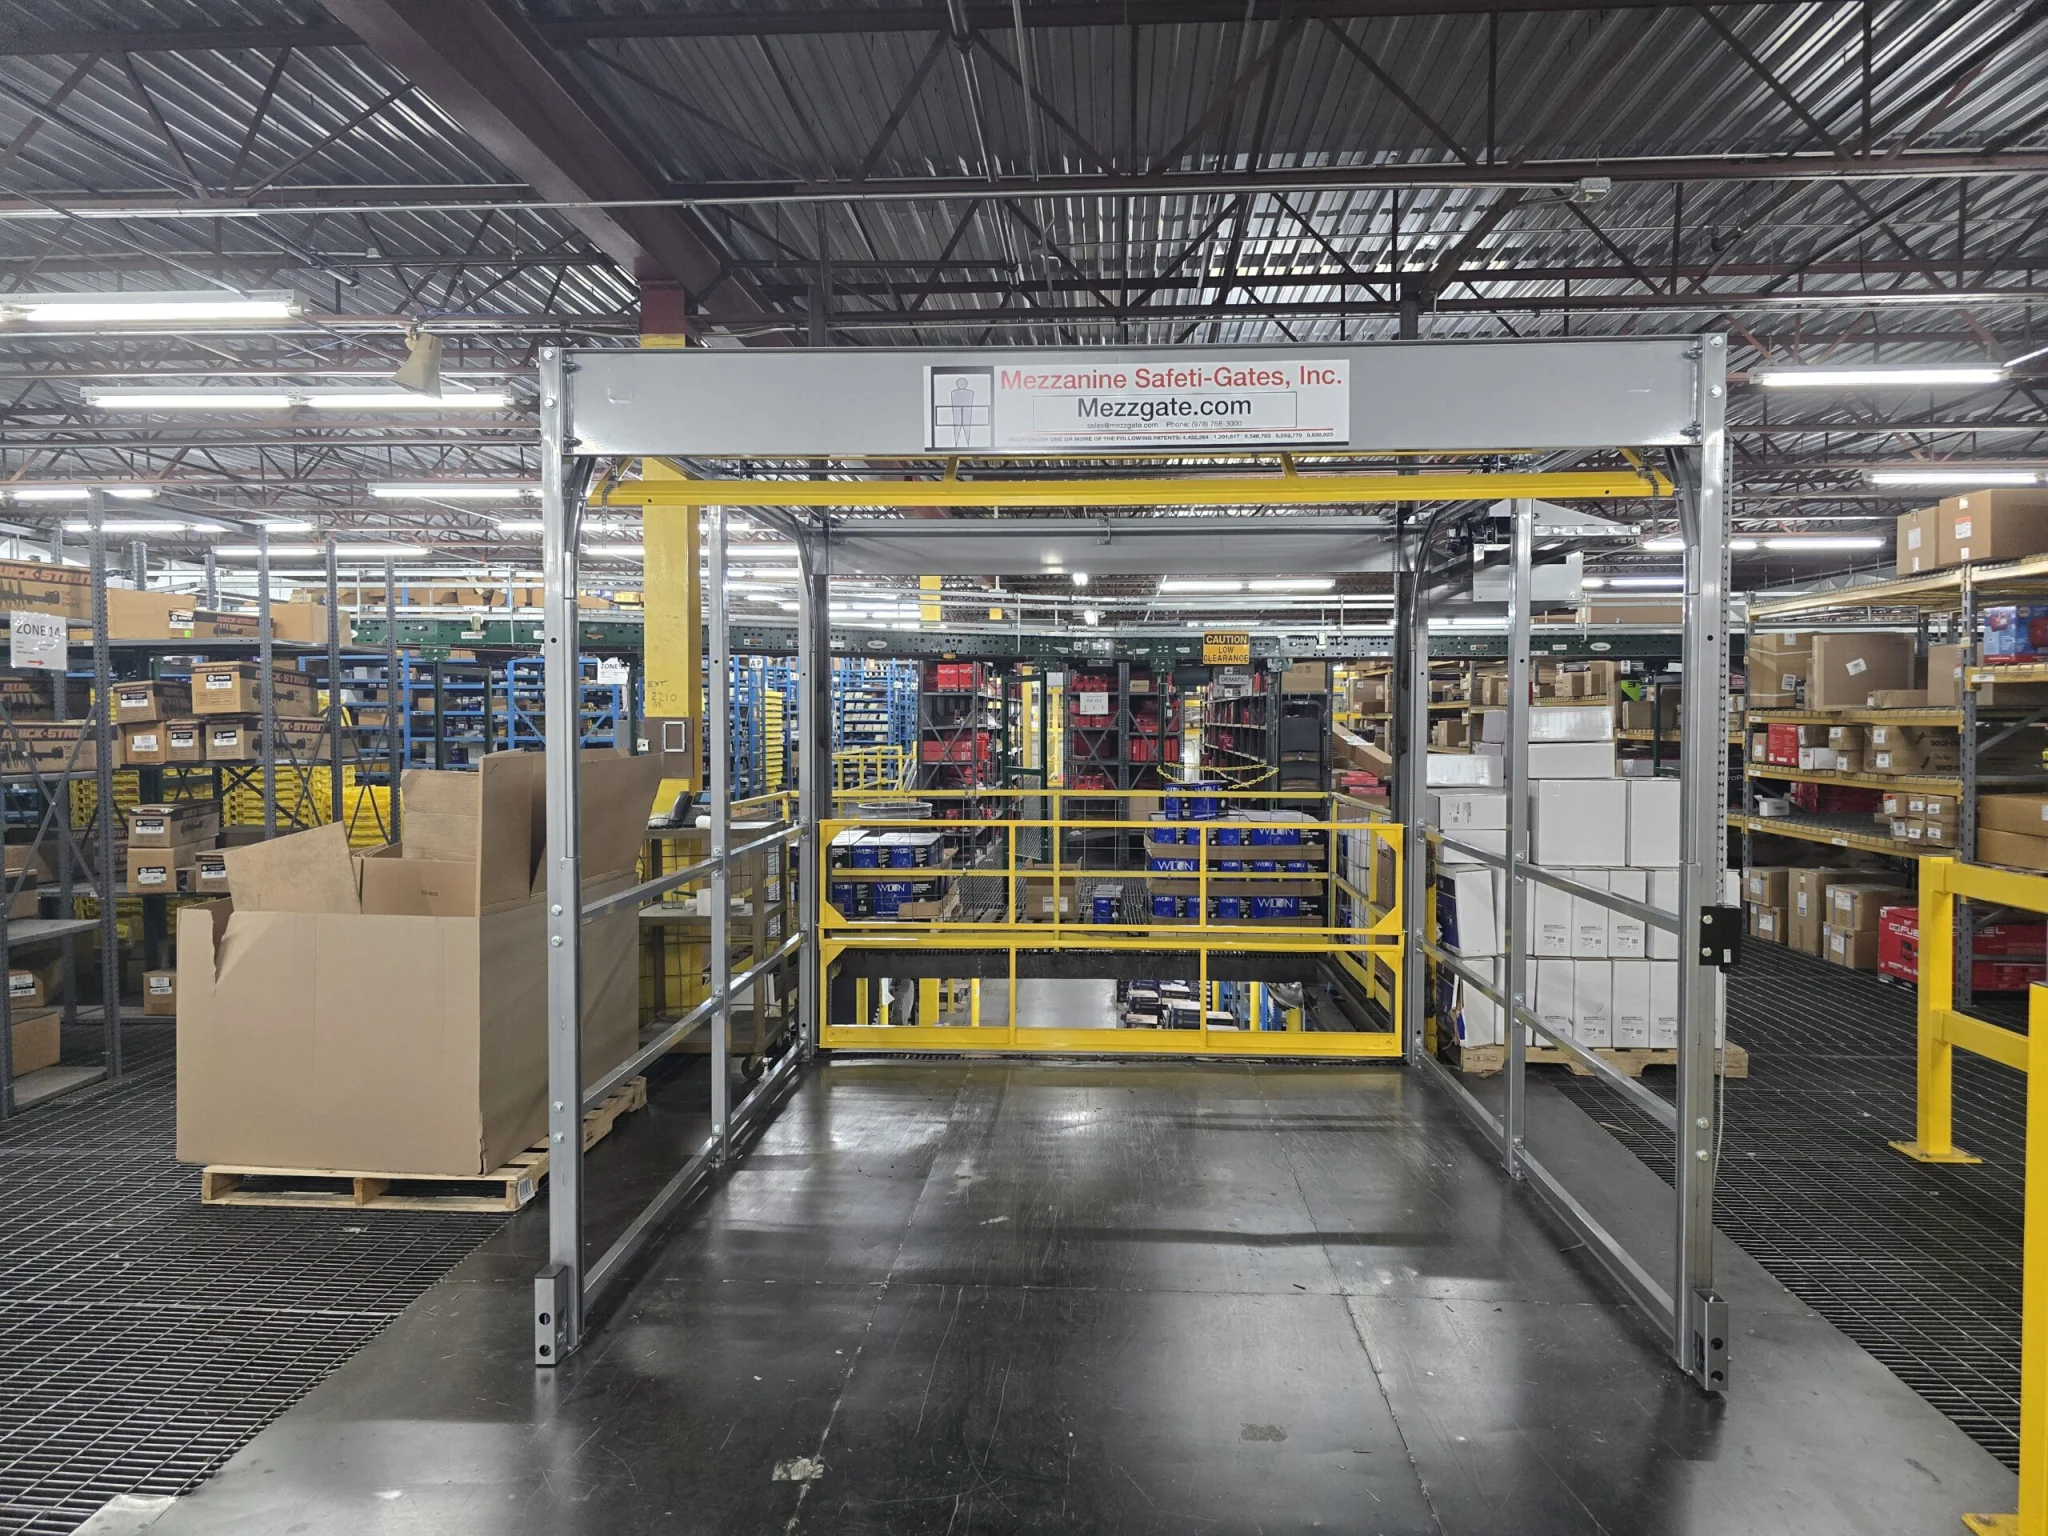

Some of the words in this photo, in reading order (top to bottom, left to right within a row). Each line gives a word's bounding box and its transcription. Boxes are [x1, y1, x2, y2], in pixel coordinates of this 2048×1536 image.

[1001, 369, 1127, 390] Mezzanine
[1135, 366, 1290, 389] Safeti-Gates,
[1300, 365, 1342, 385] Inc.
[1077, 397, 1251, 422] Mezzgate.com
[1087, 421, 1158, 430] sales@mezzgate.com
[16, 623, 46, 637] ZONE
[1206, 635, 1247, 644] CAUTION
[1218, 646, 1235, 654] LOW
[1203, 654, 1248, 662] CLEARANCE
[647, 680, 668, 688] EXT
[651, 692, 677, 702] 2210
[1900, 925, 1919, 937] FUE
